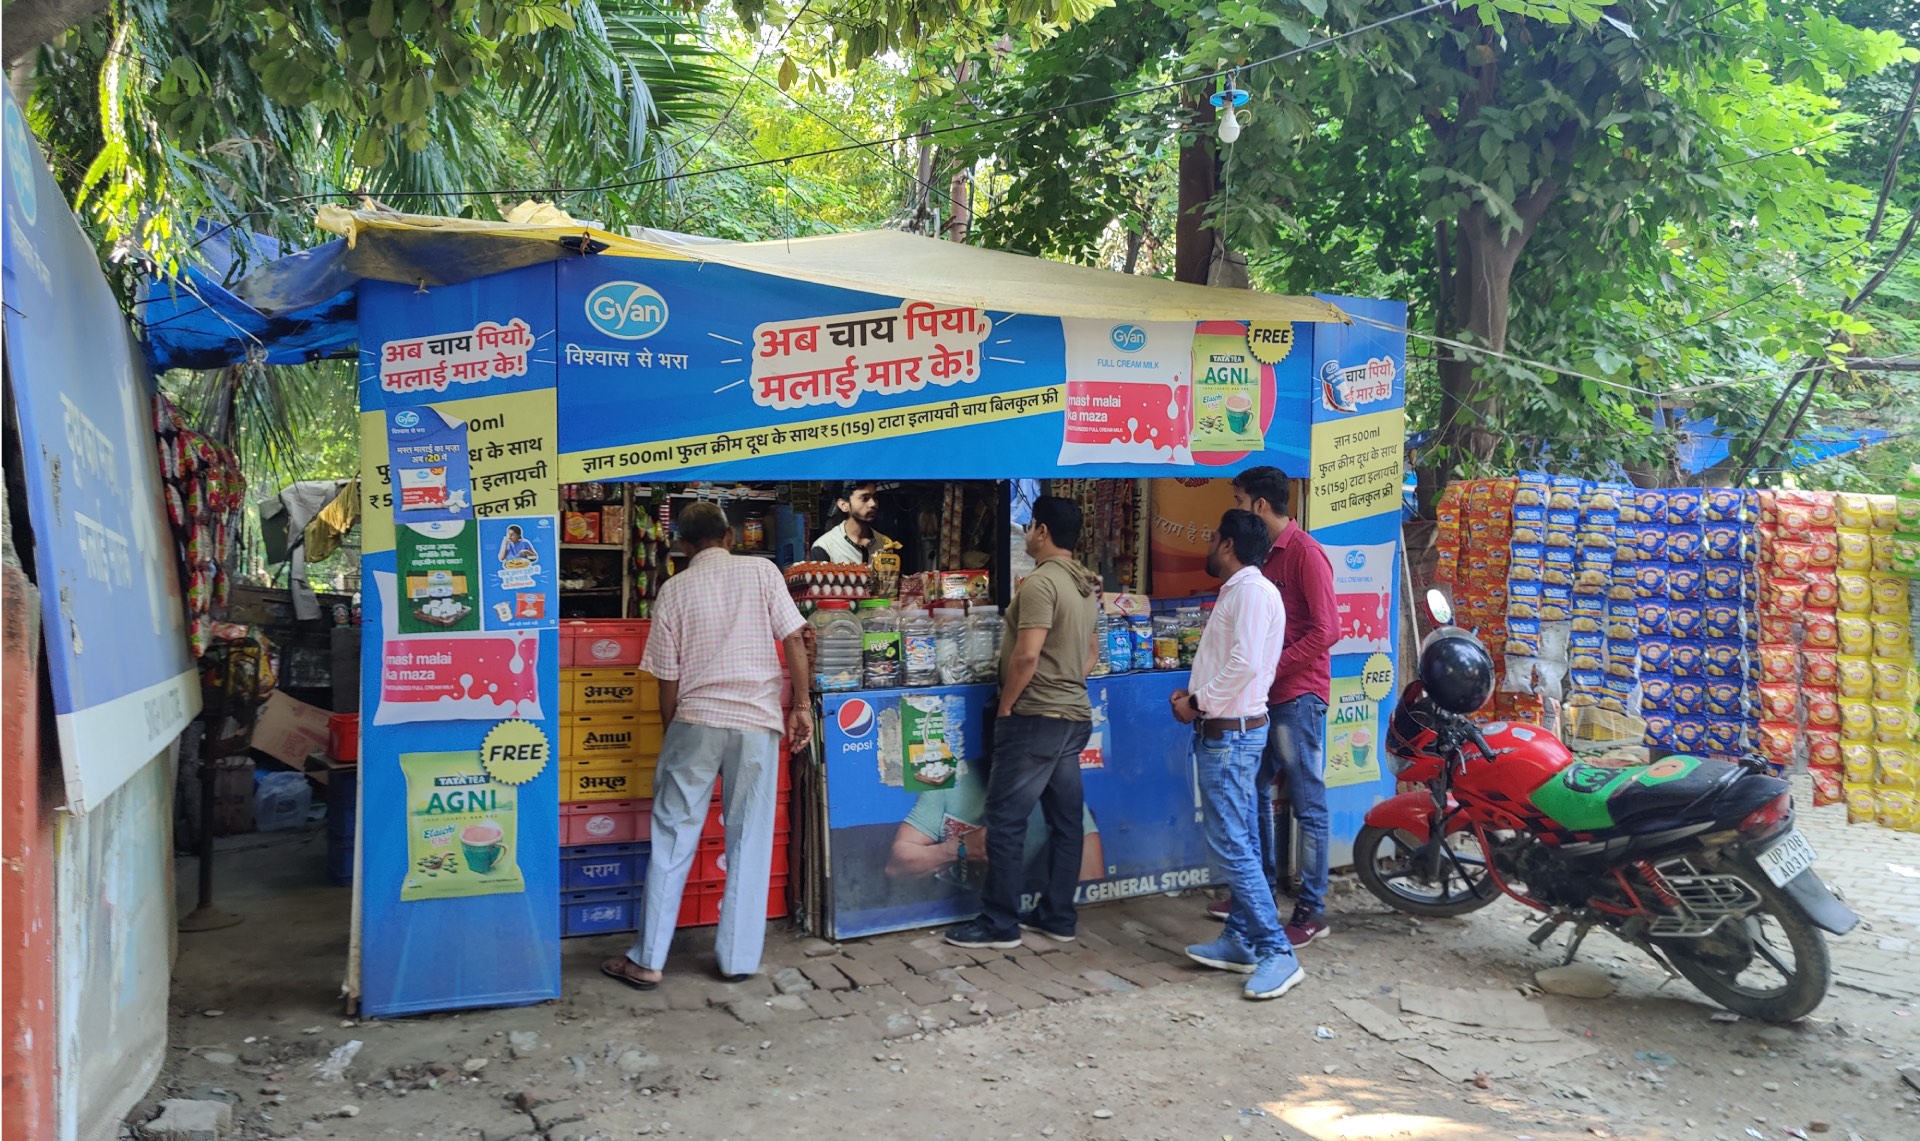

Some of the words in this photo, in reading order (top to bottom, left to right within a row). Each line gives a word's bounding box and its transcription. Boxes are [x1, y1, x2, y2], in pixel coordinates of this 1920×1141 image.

[593, 297, 661, 330] Gyan
[385, 342, 423, 363] अब
[428, 335, 472, 356] चाय
[476, 322, 532, 350] पियो,
[760, 326, 821, 358] अब
[826, 316, 898, 347] चाय
[1113, 328, 1144, 347] Gyan
[1253, 329, 1290, 344] FREE
[565, 343, 629, 367] विश्वास
[636, 347, 653, 368] से
[657, 353, 688, 370] भरा
[1097, 359, 1115, 368] FULL
[1116, 359, 1142, 369] CREAM
[1143, 361, 1159, 369] MILK
[385, 360, 447, 389] मलाई
[452, 359, 489, 382] मार
[493, 352, 524, 374] के!
[758, 355, 858, 401] मलाई
[864, 356, 923, 387] मार
[928, 343, 974, 378] के!
[1204, 366, 1248, 385] AGNI
[1345, 368, 1366, 382] चाय
[1368, 359, 1394, 379] पियो,
[1356, 386, 1374, 400] मार
[1375, 381, 1390, 397] के!
[1068, 394, 1090, 407] mast
[1092, 395, 1121, 408] malai
[466, 413, 504, 432] 0ml
[1067, 409, 1077, 420] ka
[1079, 412, 1108, 422] maza
[582, 454, 615, 474] ज्ञान
[619, 446, 673, 467] 500ml
[676, 442, 707, 464] फुल
[710, 434, 743, 455] क्रीम
[745, 432, 769, 454] दूध
[771, 427, 787, 445] के
[790, 426, 819, 443] साथ
[878, 415, 905, 429] टाटा
[907, 402, 960, 428] इलायची
[962, 401, 987, 416] चाय
[989, 393, 1040, 415] बिलकुल
[1040, 388, 1059, 405] फ्री
[1334, 434, 1351, 449] ज्ञान
[1352, 426, 1380, 443] 500ml
[485, 441, 504, 459] के
[506, 437, 543, 456] साथ
[1318, 460, 1336, 479] फुल
[1337, 455, 1355, 472] क्रीम
[1356, 451, 1370, 469] दूध
[1370, 447, 1379, 460] के
[1380, 444, 1398, 457] साथ
[480, 460, 548, 492] इलायची
[1349, 473, 1366, 488] टाटा
[1367, 463, 1399, 485] इलायची
[512, 489, 537, 510] फ्री
[1329, 499, 1347, 512] चाय
[1349, 489, 1381, 508] बिलकुल
[1382, 482, 1394, 499] फ्री
[1347, 553, 1366, 568] Gyan
[385, 652, 413, 666] mast
[416, 652, 452, 665] malai
[385, 669, 397, 681] ka
[400, 670, 436, 680] maza
[1365, 670, 1391, 684] FREE
[584, 686, 634, 699] अमूल
[1335, 704, 1369, 724] AGNI
[583, 731, 632, 746] Amul
[842, 739, 873, 753] pepsi
[489, 743, 544, 762] FREE
[438, 777, 466, 785] TATA
[468, 775, 486, 784] TEA
[579, 776, 627, 790] अमूल
[425, 789, 496, 816] AGNI
[582, 862, 621, 878] पराग
[1086, 875, 1158, 901] GENERAL
[1161, 868, 1210, 890] STORE
